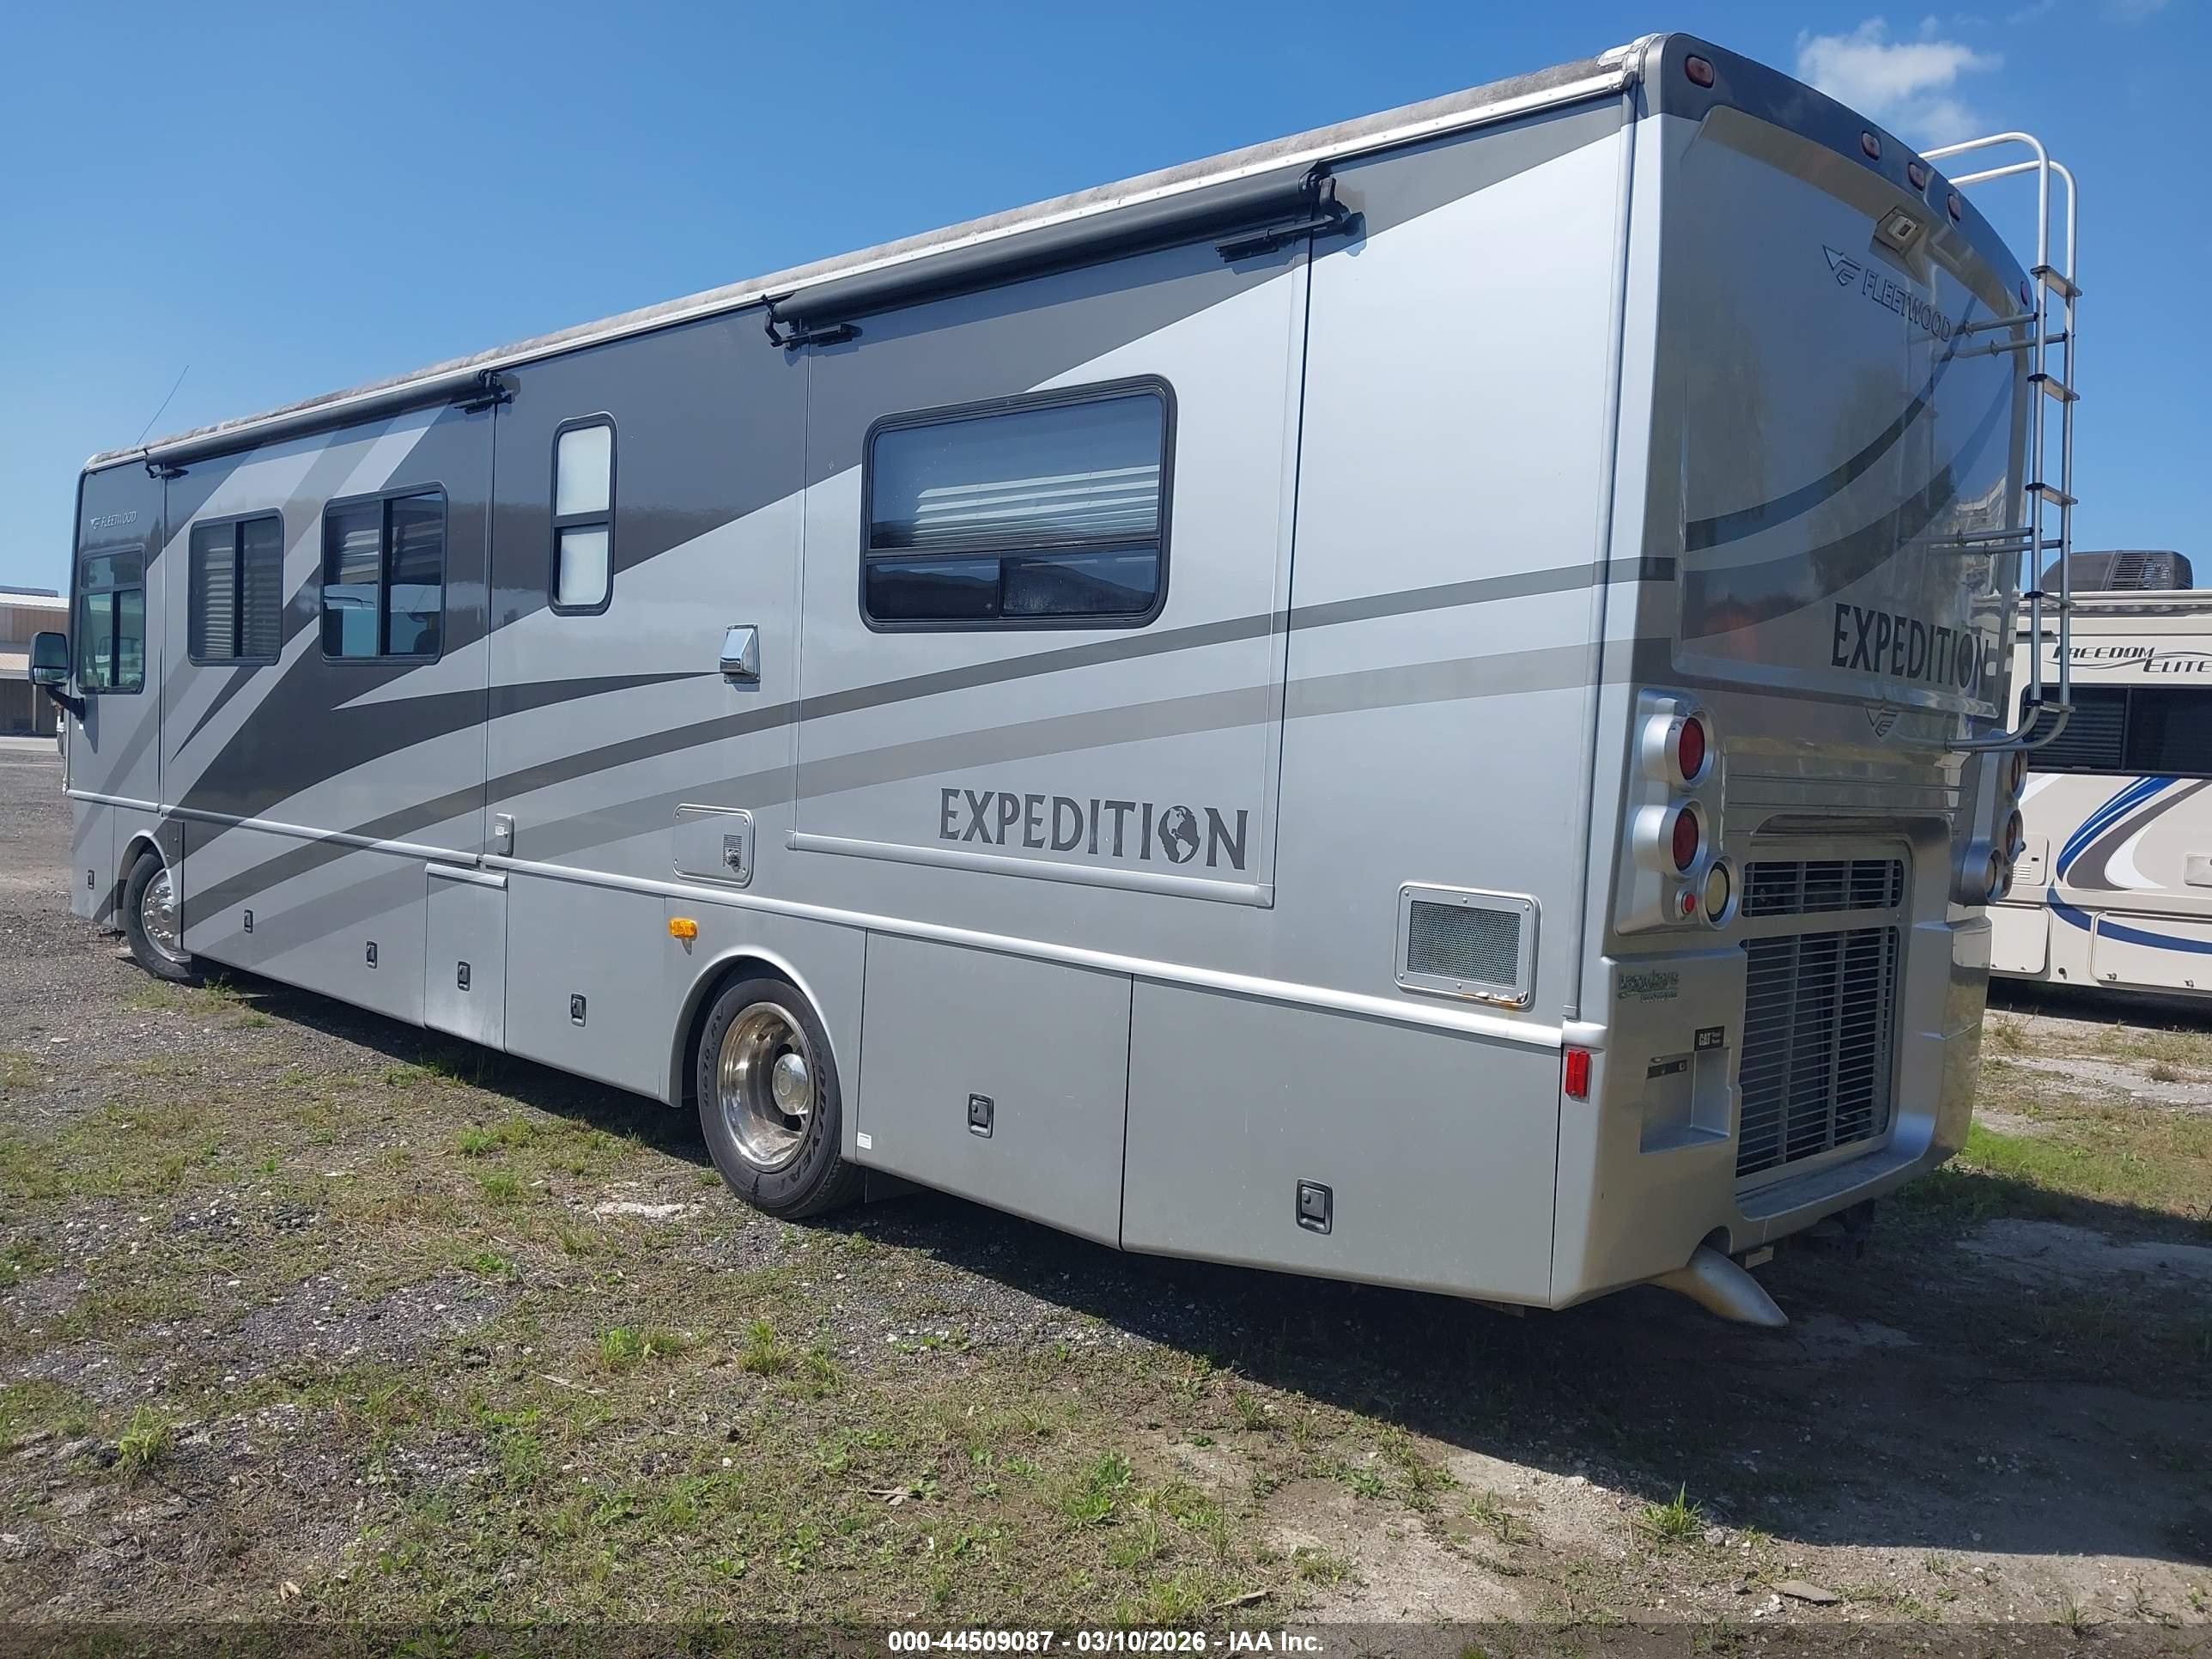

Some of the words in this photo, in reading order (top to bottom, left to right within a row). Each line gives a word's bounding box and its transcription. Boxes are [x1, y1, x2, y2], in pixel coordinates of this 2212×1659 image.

[1862, 268, 1952, 342] FLEETWOOD
[101, 511, 137, 528] FLEETWOOD
[1831, 602, 1990, 692] EXPEDITION
[2143, 658, 2212, 672] ELITE
[939, 787, 1249, 871] EXPEDITION
[1698, 1033, 1711, 1047] CAT
